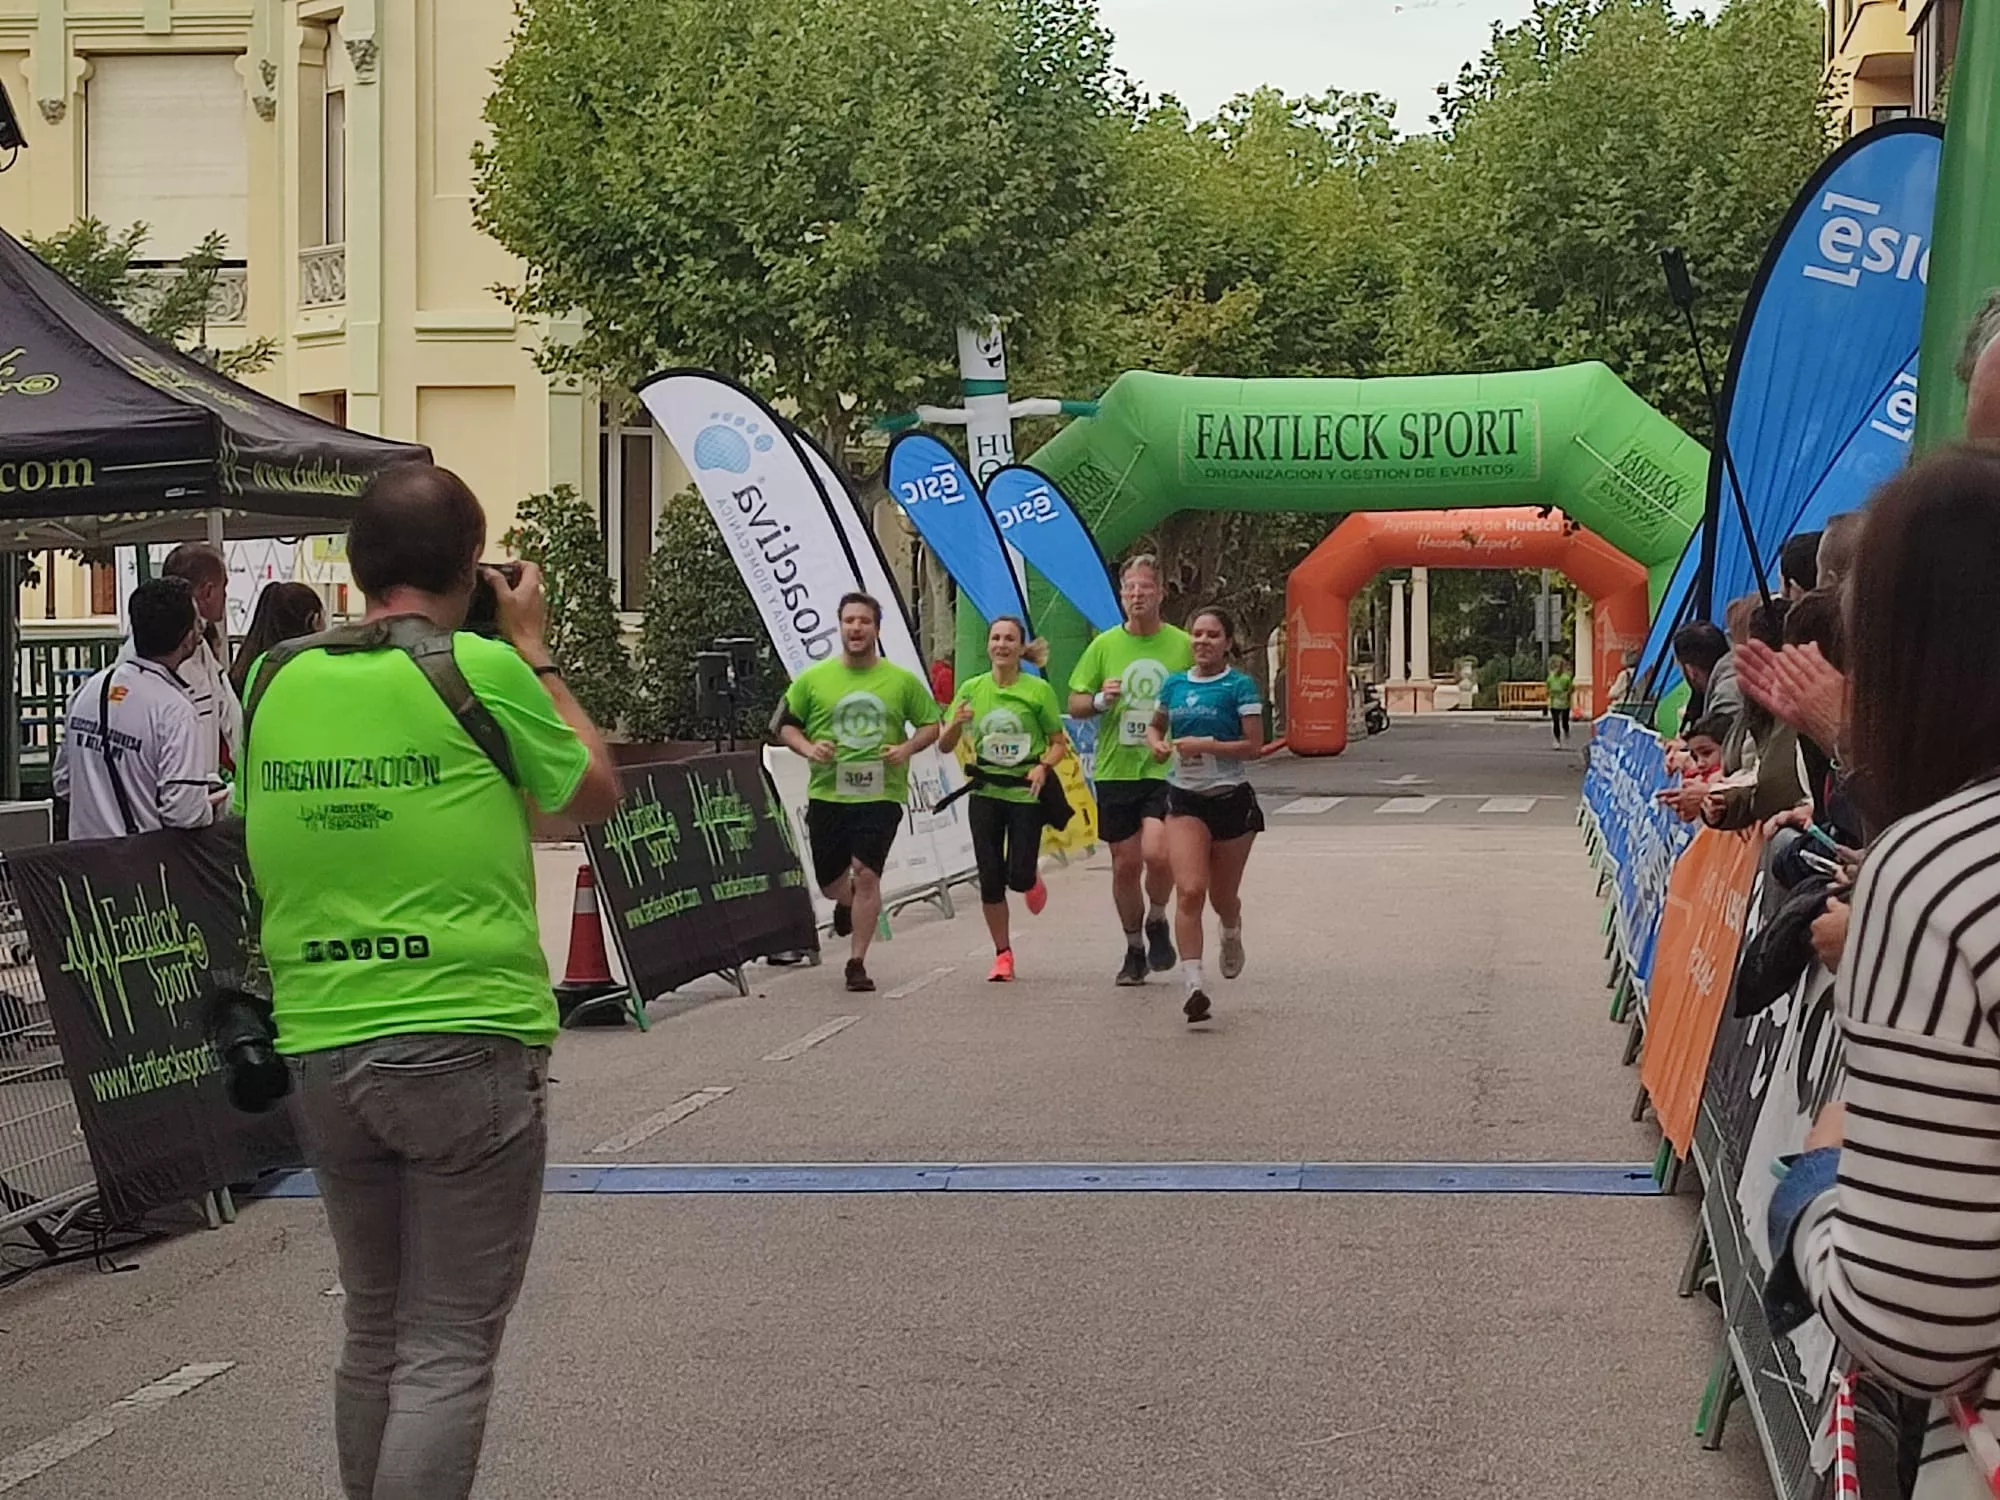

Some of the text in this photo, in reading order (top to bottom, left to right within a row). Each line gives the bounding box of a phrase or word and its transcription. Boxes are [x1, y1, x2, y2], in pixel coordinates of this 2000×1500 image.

[1194, 409, 1524, 461] FARTLECK SPORT
[1326, 469, 1336, 480] Y
[1414, 467, 1436, 479] DE
[1440, 464, 1514, 478] EVENTOS
[1485, 519, 1501, 531] de
[1505, 519, 1560, 532] Huesca
[1127, 722, 1146, 734] 39
[100, 862, 184, 957] Fartleck
[146, 948, 201, 1029] Sport
